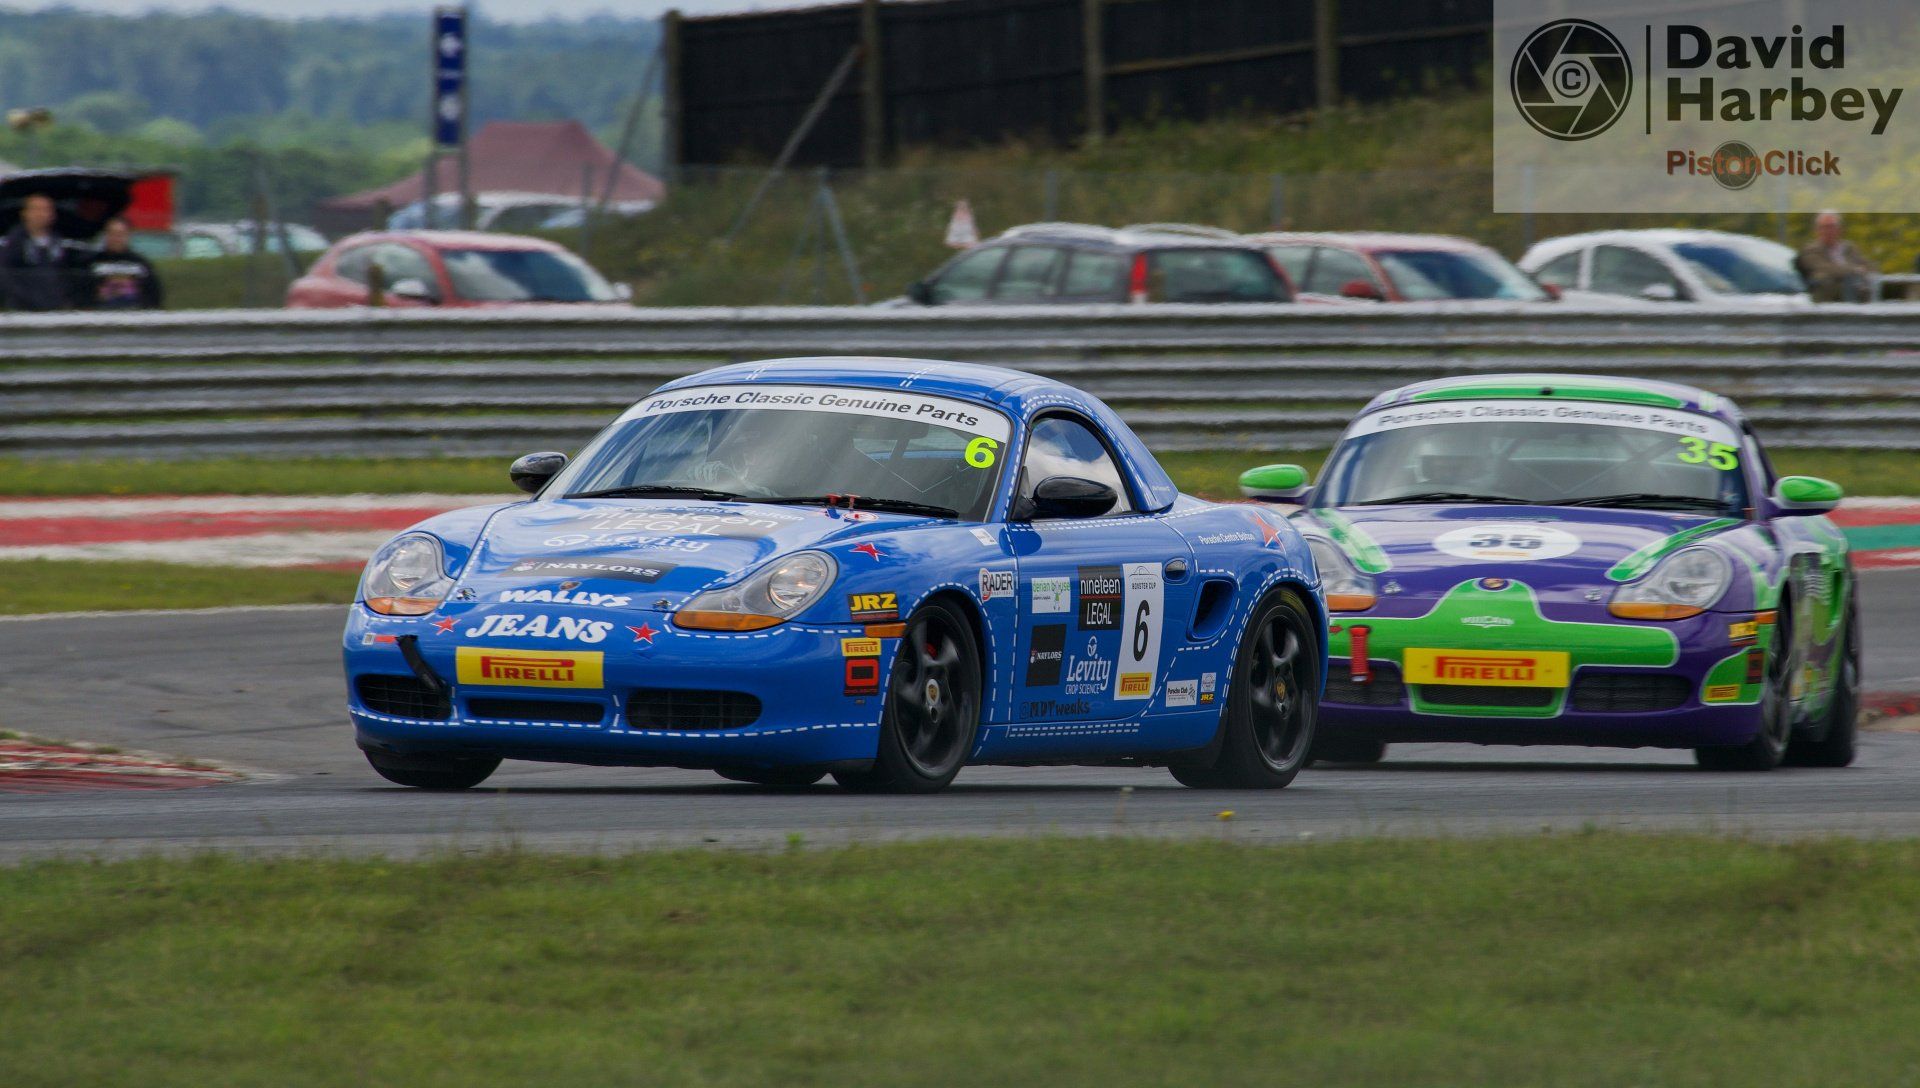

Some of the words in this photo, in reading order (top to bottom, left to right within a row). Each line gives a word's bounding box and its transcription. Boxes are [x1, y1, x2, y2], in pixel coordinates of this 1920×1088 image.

[646, 392, 731, 412] Porsche
[735, 392, 814, 406] Classic
[818, 394, 912, 414] Genuine
[915, 404, 979, 427] Parts
[1377, 408, 1464, 427] Porsche
[1469, 406, 1547, 419] Classic
[1553, 406, 1643, 424] Genuine
[1648, 414, 1709, 435] Parts
[964, 436, 999, 469] 6
[1676, 436, 1739, 471] 35
[590, 519, 721, 537] LEGAL
[593, 532, 712, 553] Levity
[546, 561, 661, 577] NAYLORS
[982, 573, 1013, 592] RADER
[1080, 575, 1121, 595] nineteen
[500, 589, 633, 608] WALLYS
[850, 593, 898, 612] JRZ
[1086, 602, 1112, 625] LEGAL
[465, 614, 615, 644] JEANS
[1133, 599, 1150, 662] 6
[845, 641, 878, 653] PIRELLI
[1036, 651, 1063, 661] NAYLORS
[480, 656, 576, 682] PIRELLI
[1066, 653, 1112, 691] Levity
[1434, 656, 1537, 681] PIRELLI
[1065, 684, 1078, 695] CROP
[1078, 683, 1102, 695] SCIENCE
[1121, 676, 1150, 692] PIRELLI
